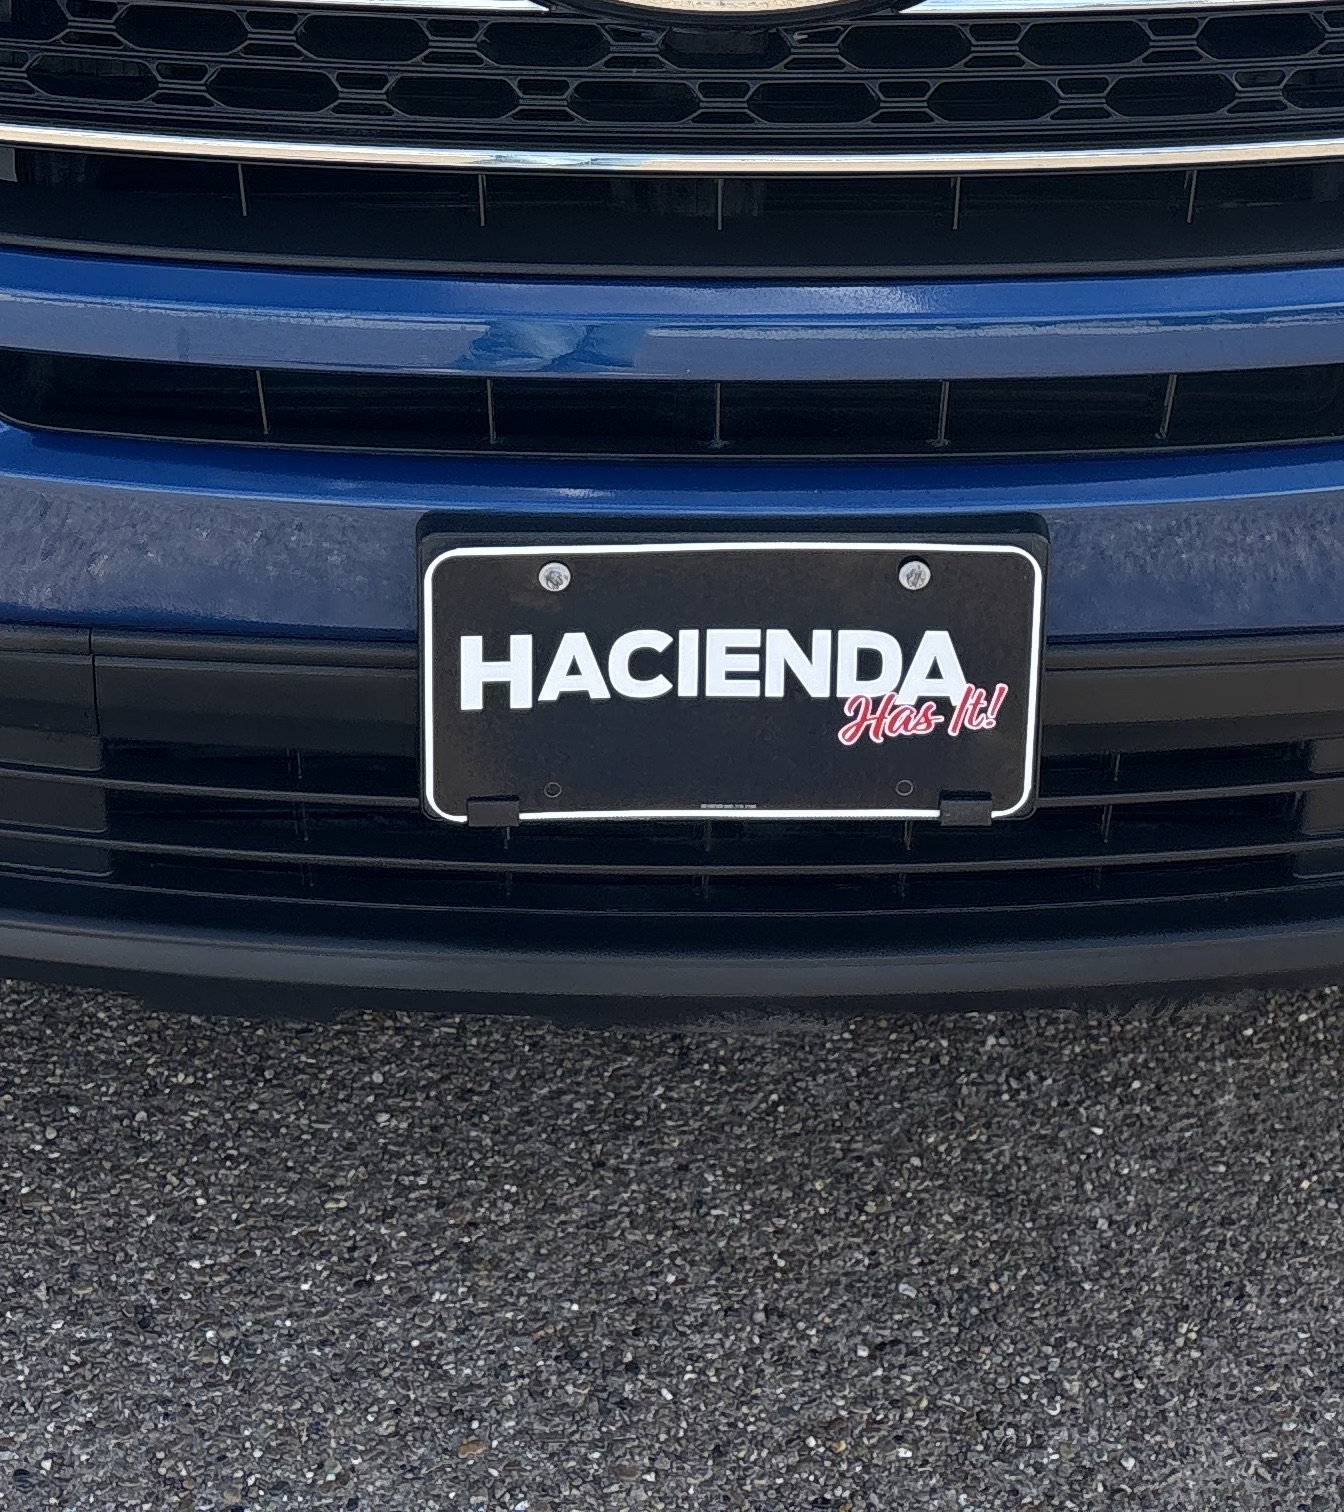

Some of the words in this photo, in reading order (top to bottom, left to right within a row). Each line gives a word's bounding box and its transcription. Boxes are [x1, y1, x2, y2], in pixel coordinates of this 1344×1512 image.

[460, 629, 968, 710] HACIENDA
[838, 692, 944, 745] Has
[948, 683, 1008, 736] It!
